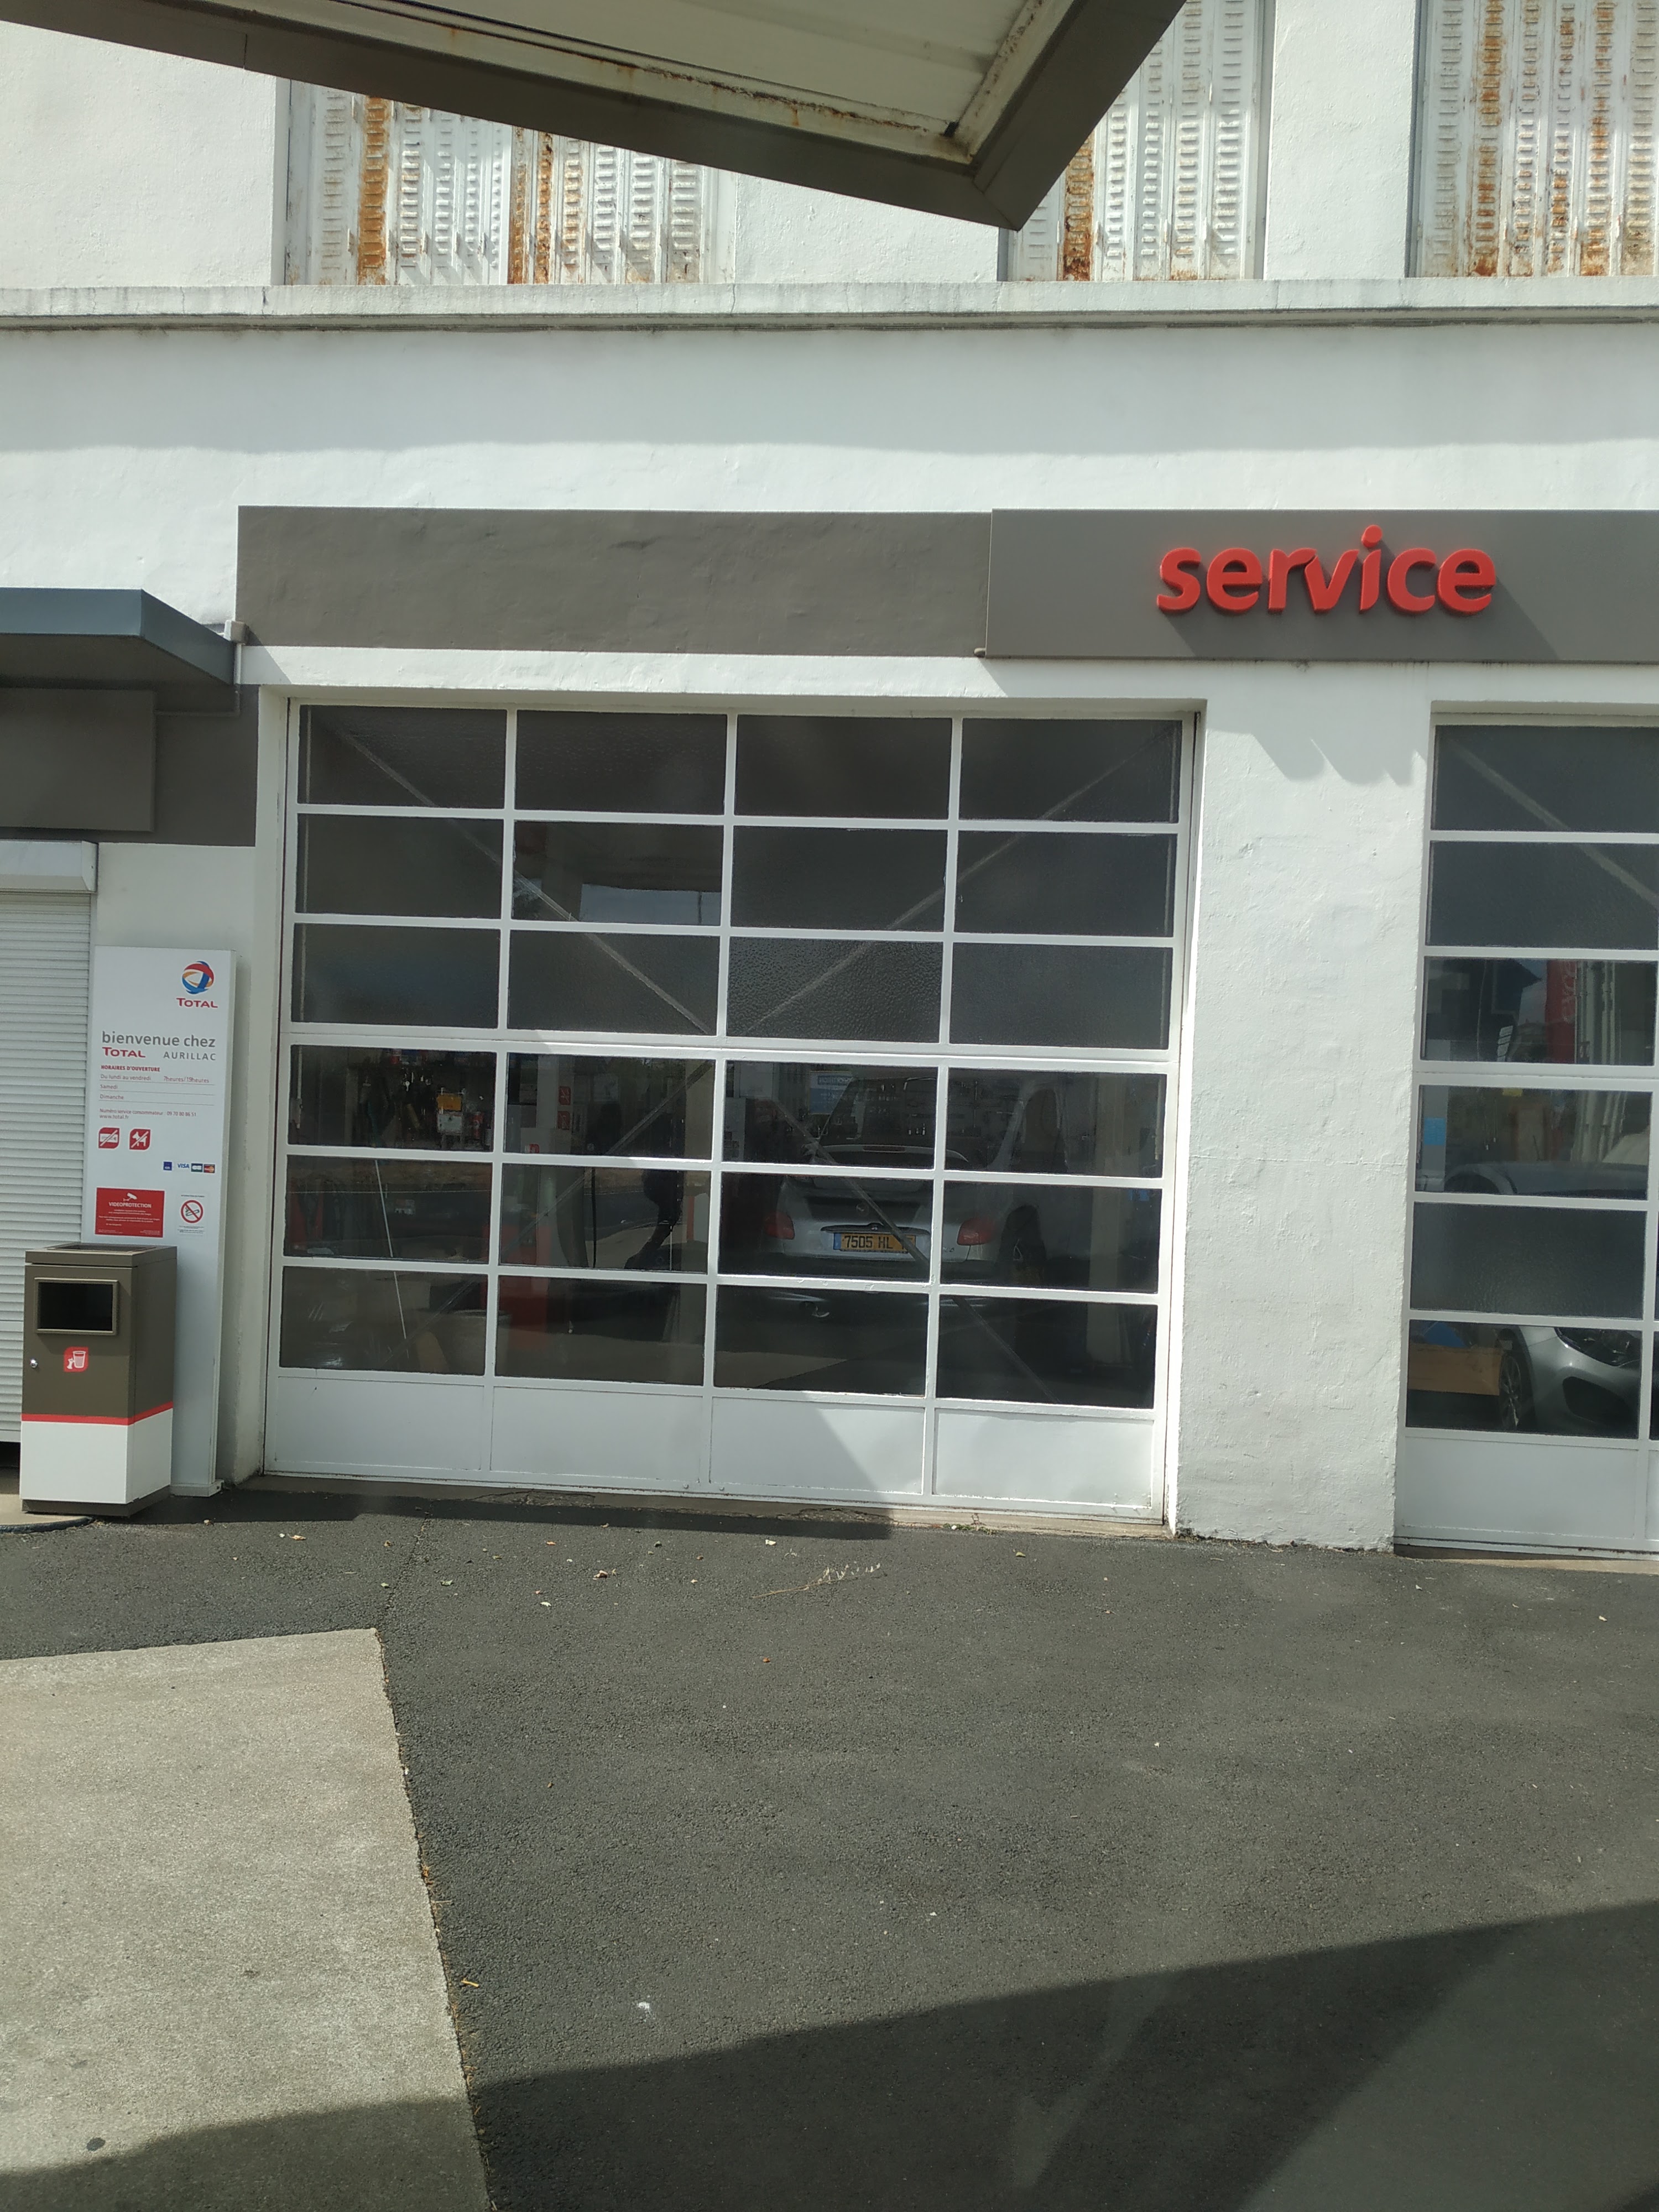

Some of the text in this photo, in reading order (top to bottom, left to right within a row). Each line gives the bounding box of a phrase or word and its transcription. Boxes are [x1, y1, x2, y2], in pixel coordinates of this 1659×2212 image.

[1157, 524, 1496, 615] service
[176, 998, 218, 1008] TOTAL
[102, 1030, 216, 1048] bienvenue chez
[102, 1046, 216, 1061] TOTAL AURILLAC
[844, 1235, 873, 1249] 7505
[878, 1236, 894, 1249] HL
